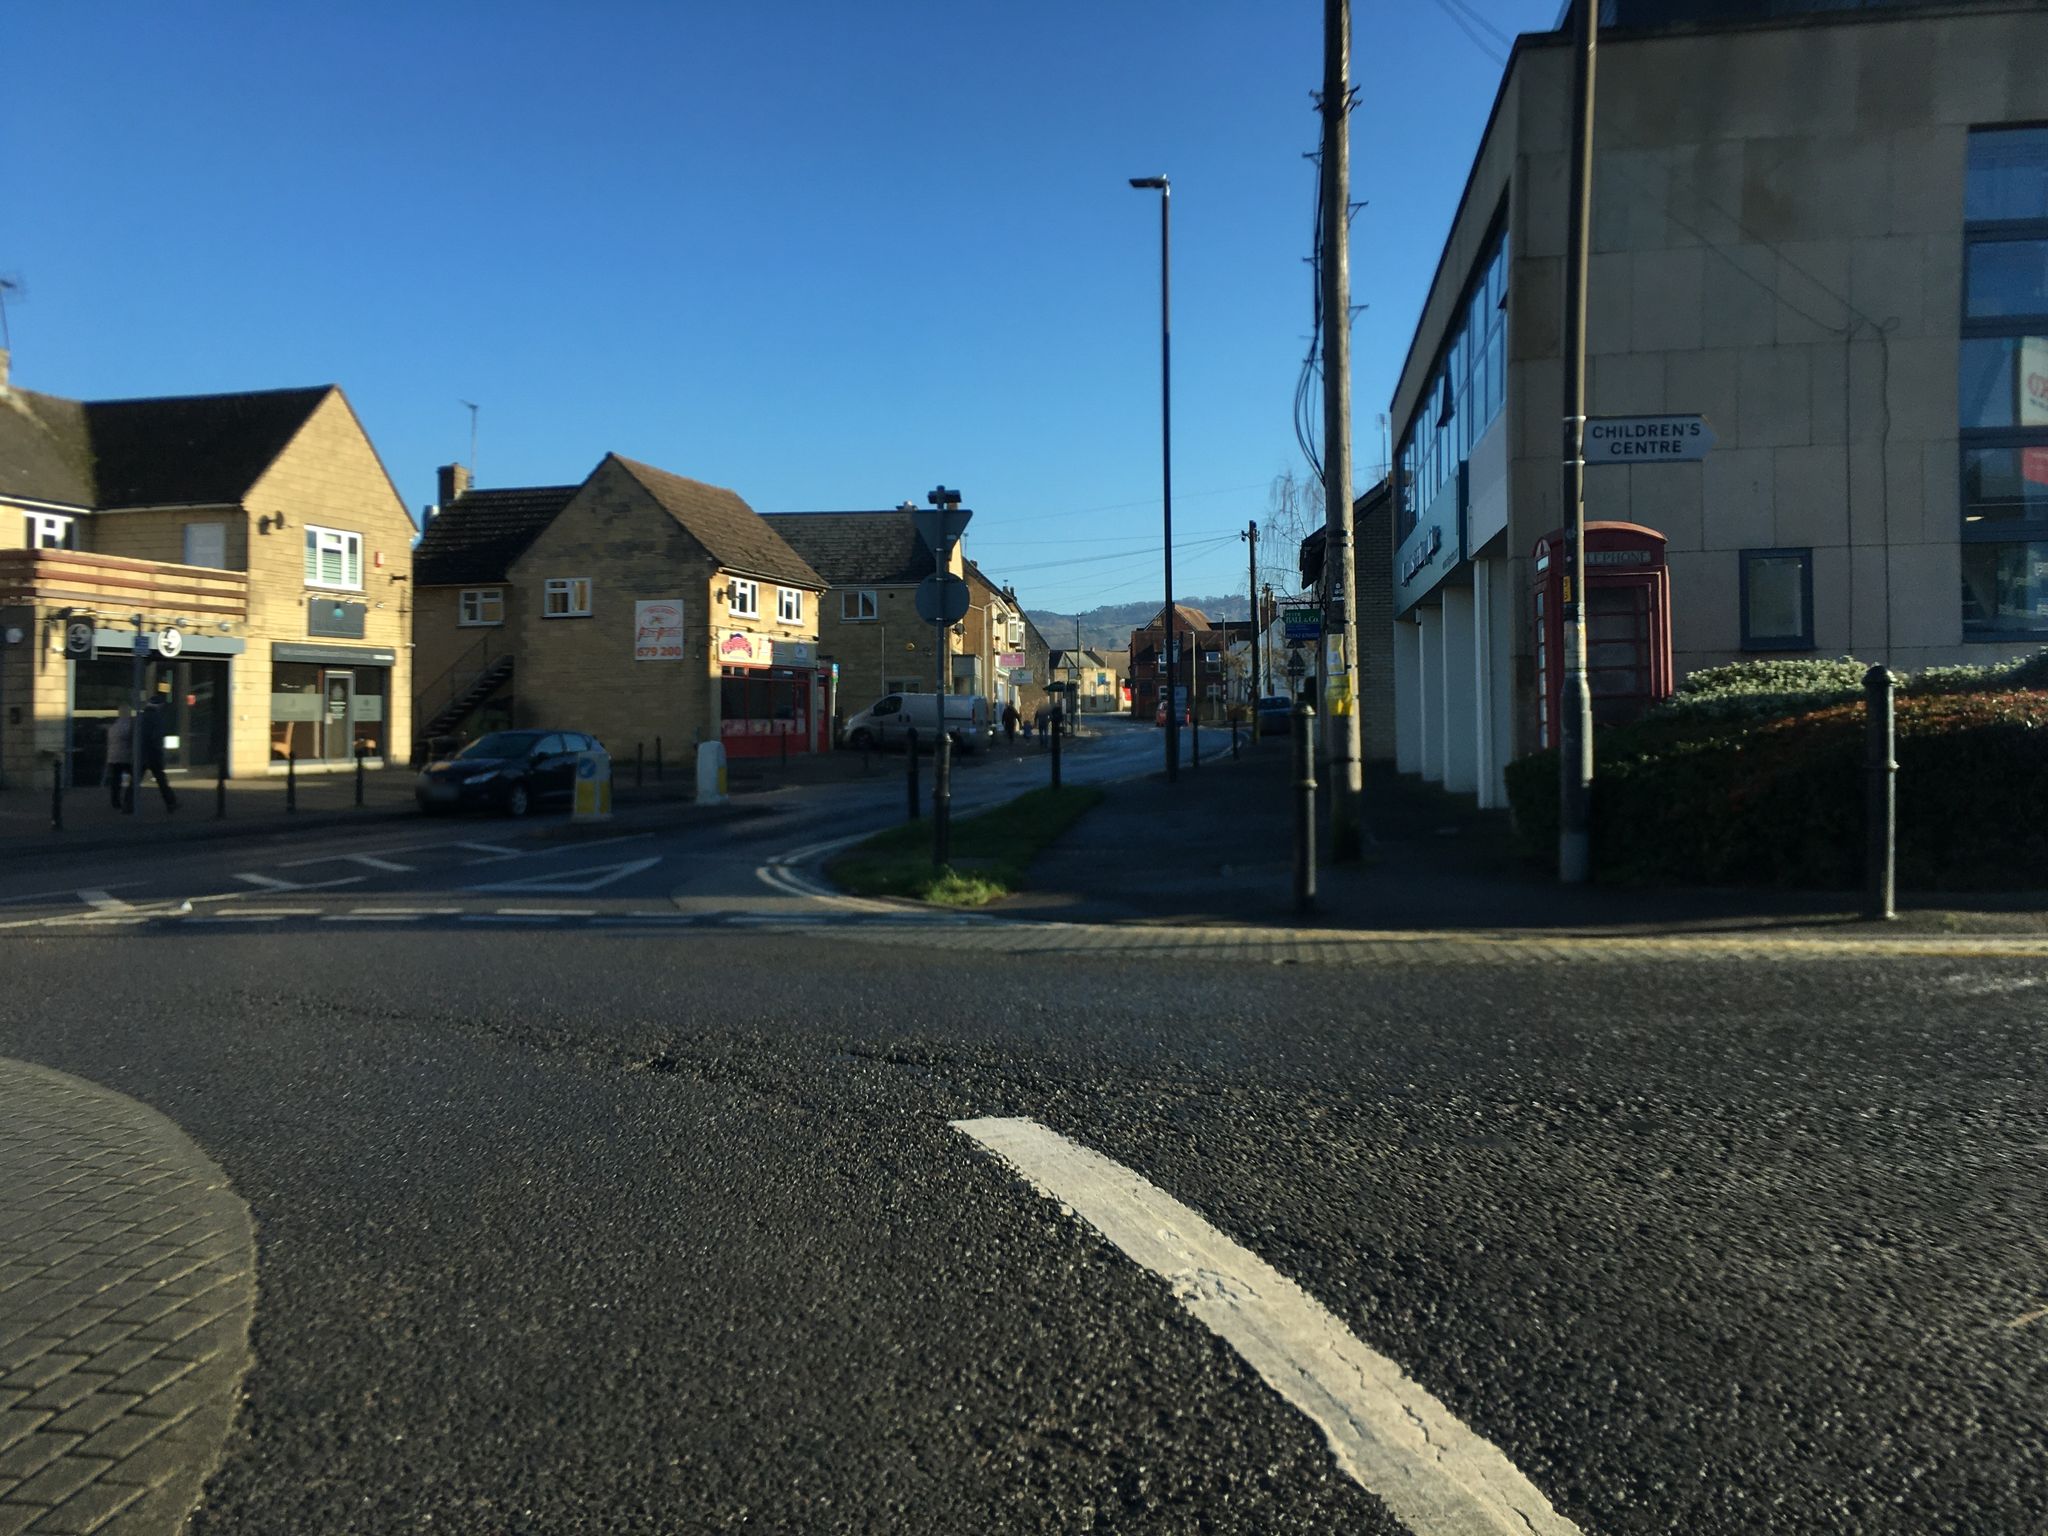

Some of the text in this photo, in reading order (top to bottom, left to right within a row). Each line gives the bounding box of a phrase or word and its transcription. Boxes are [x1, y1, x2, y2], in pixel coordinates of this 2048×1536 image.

[1592, 423, 1701, 439] CHILDREN'S
[1610, 440, 1682, 455] CENTRE
[1585, 551, 1649, 563] LEPHONE
[637, 646, 657, 657] 679
